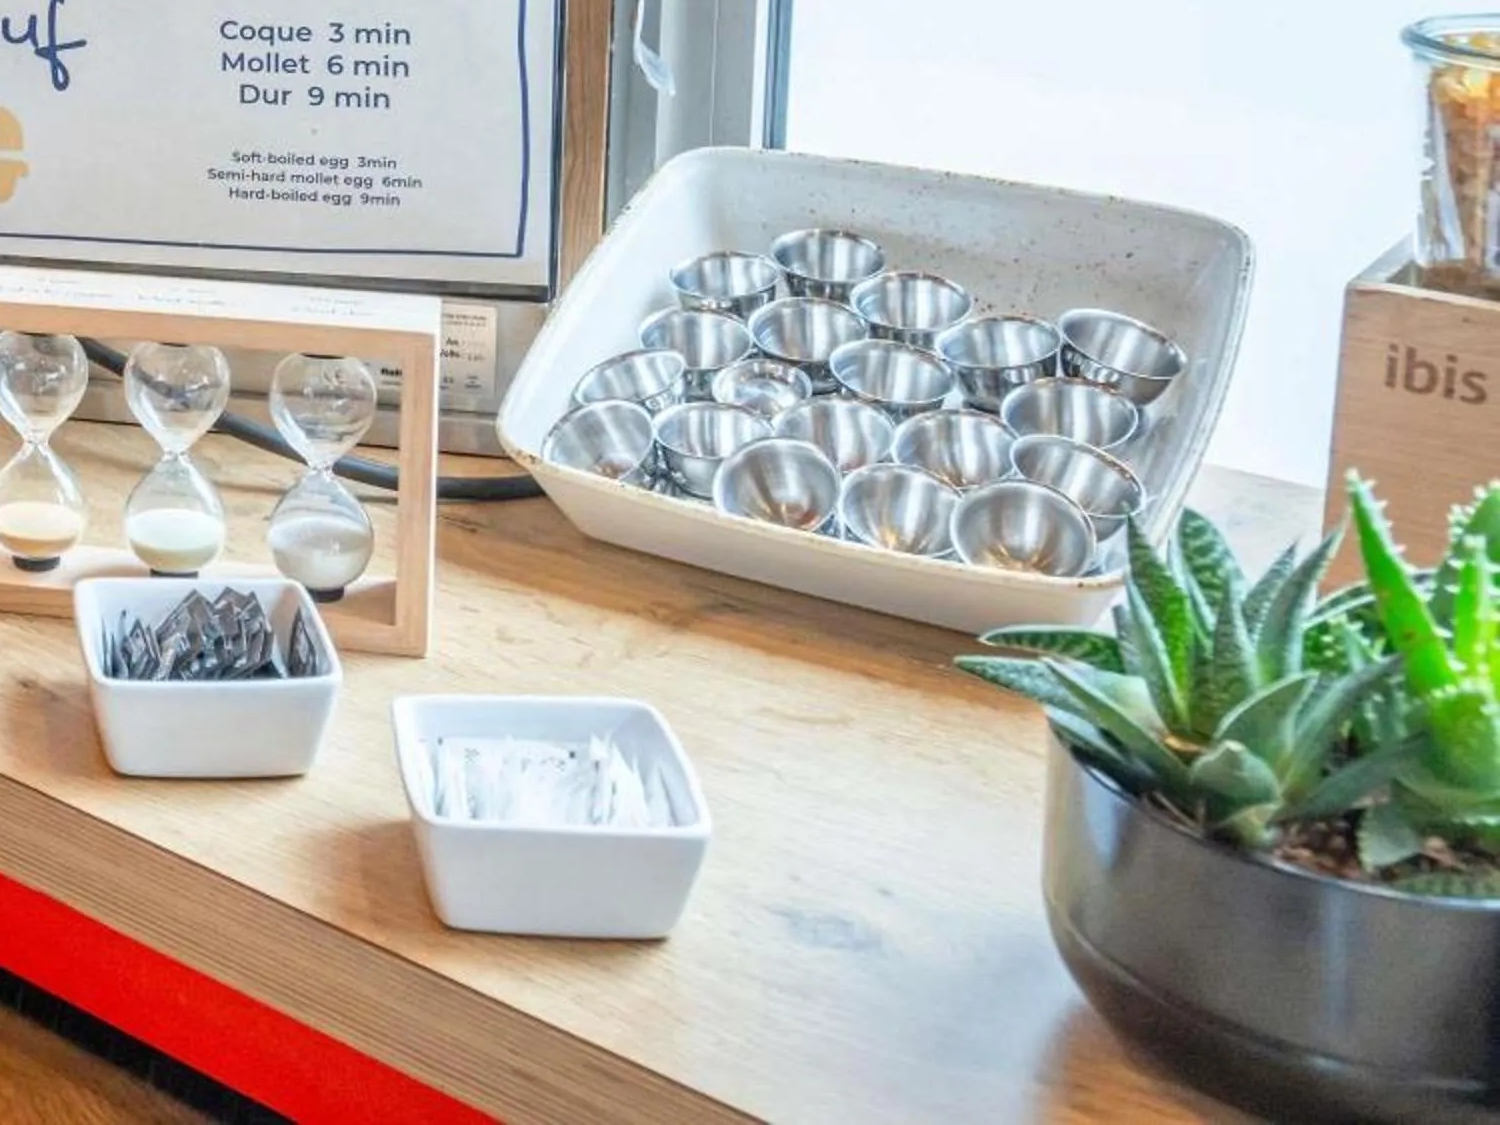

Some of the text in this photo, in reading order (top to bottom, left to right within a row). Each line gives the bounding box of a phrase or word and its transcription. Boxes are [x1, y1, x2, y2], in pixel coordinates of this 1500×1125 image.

[219, 20, 411, 46] Coque 3 min
[221, 52, 410, 77] Mollet 6 min
[239, 84, 391, 108] Dur 9 min
[319, 157, 349, 169] egg
[357, 156, 397, 169] 3min
[207, 168, 423, 189] Semi-hard mollet egg 6min
[229, 187, 401, 206] Hard-boiled egg 9min
[1384, 343, 1488, 405] ibis
